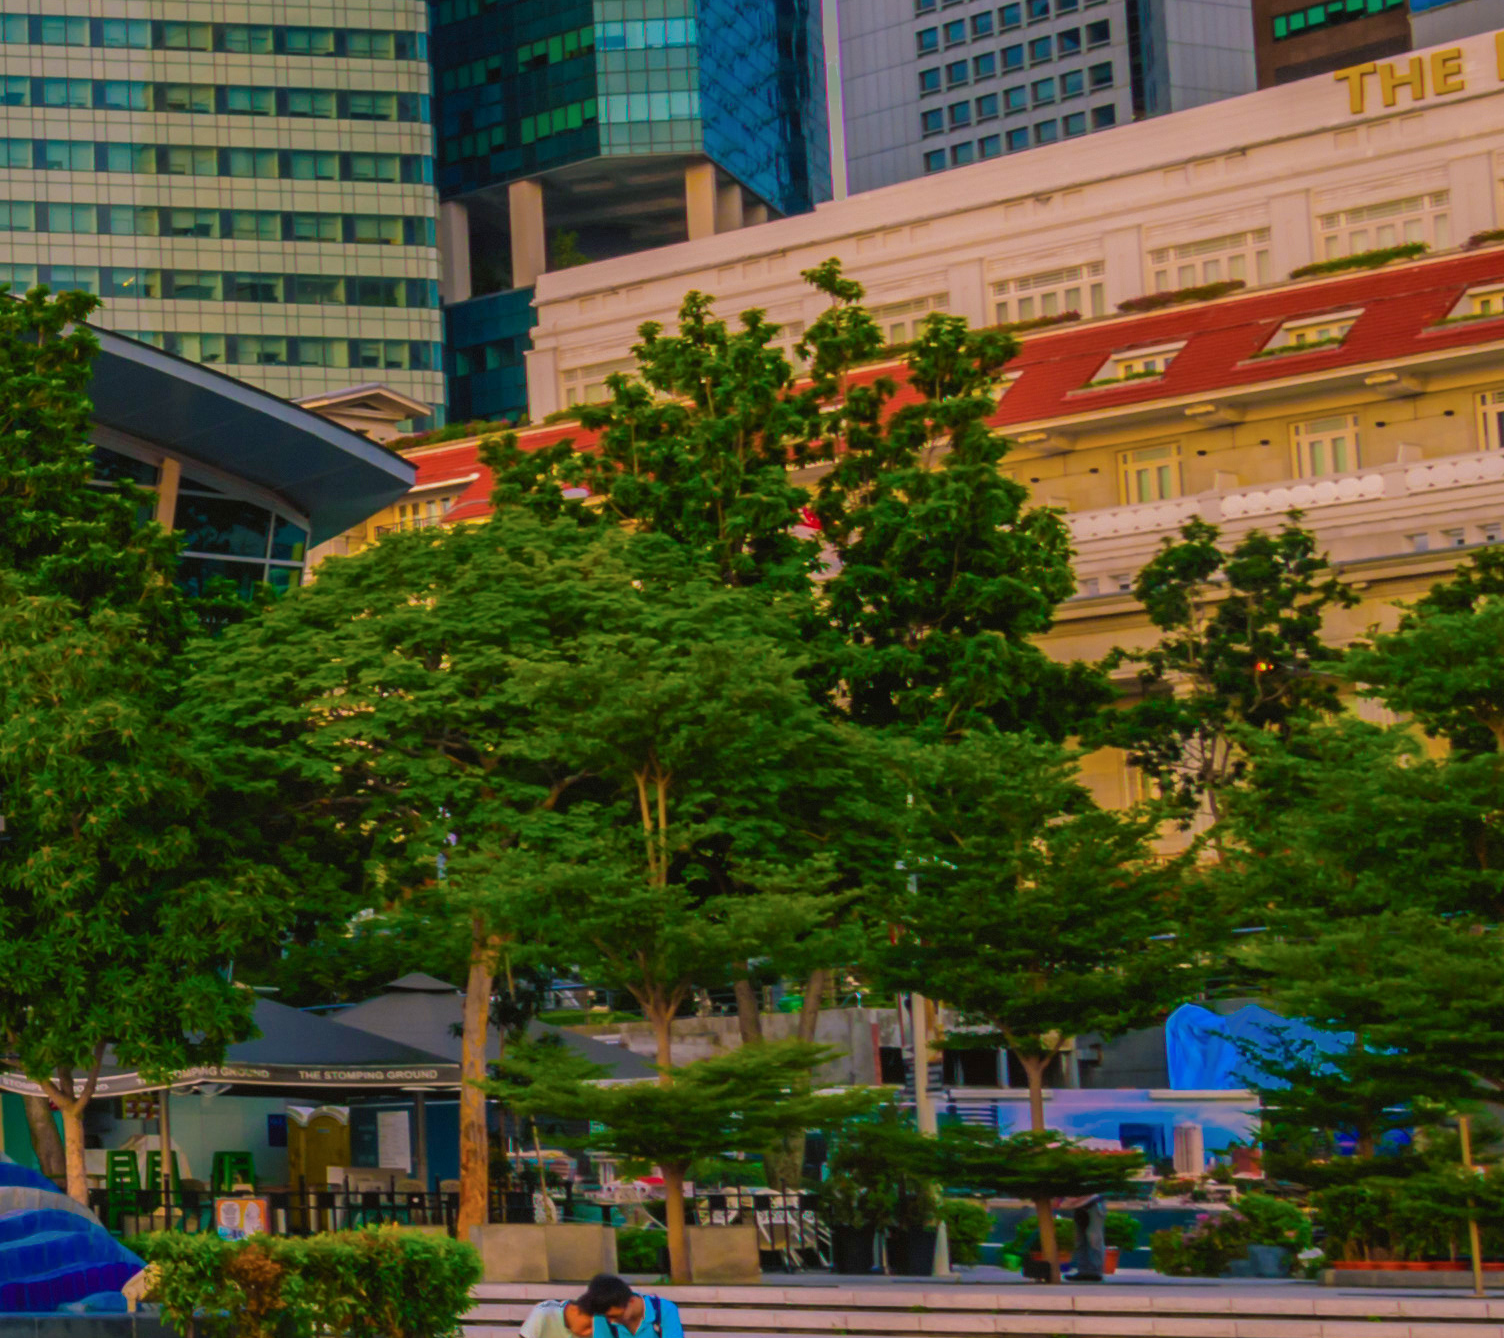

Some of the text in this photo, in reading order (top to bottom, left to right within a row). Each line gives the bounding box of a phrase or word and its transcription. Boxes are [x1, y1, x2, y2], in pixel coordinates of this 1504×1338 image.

[1334, 47, 1465, 115] THE
[299, 1069, 438, 1080] THE STOMPING GROUND
